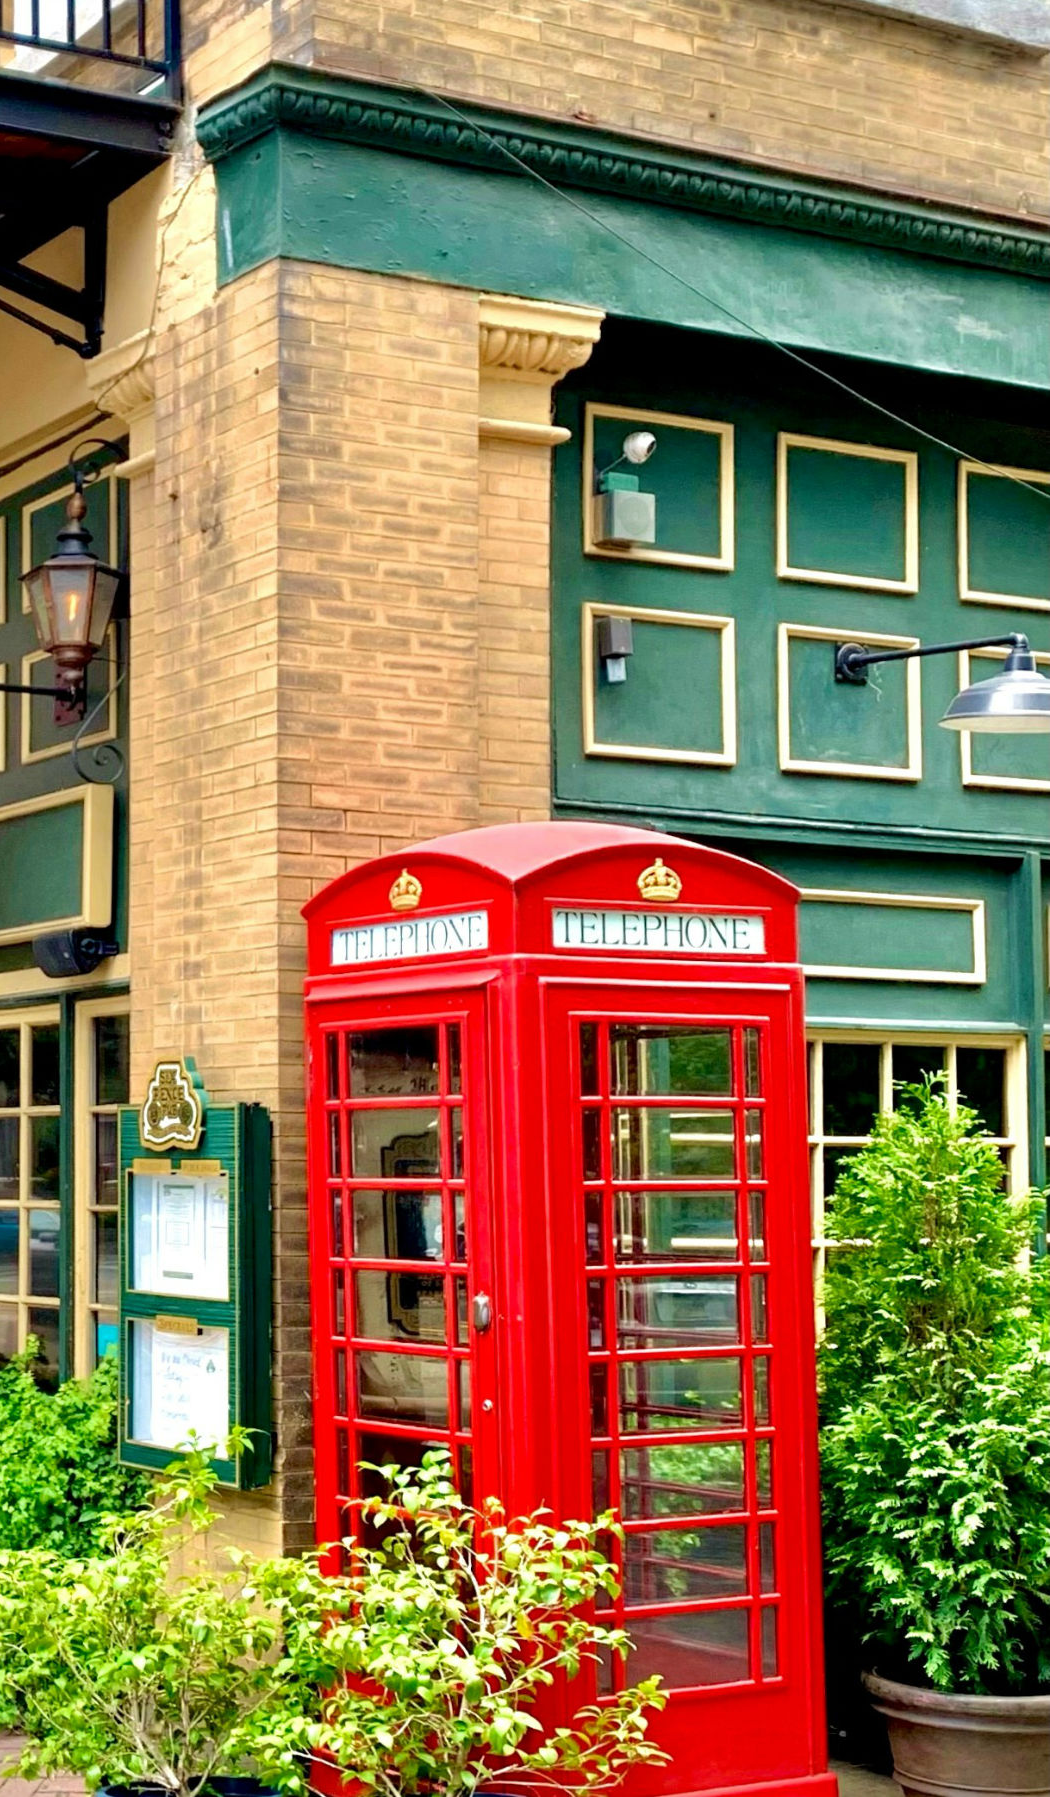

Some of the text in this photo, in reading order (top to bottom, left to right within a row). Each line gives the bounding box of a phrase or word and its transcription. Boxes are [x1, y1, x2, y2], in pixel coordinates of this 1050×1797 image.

[340, 915, 483, 961] TELEPHONE
[556, 911, 750, 949] TELEPHONE
[159, 1070, 178, 1084] SIX
[153, 1086, 185, 1102] PENCE
